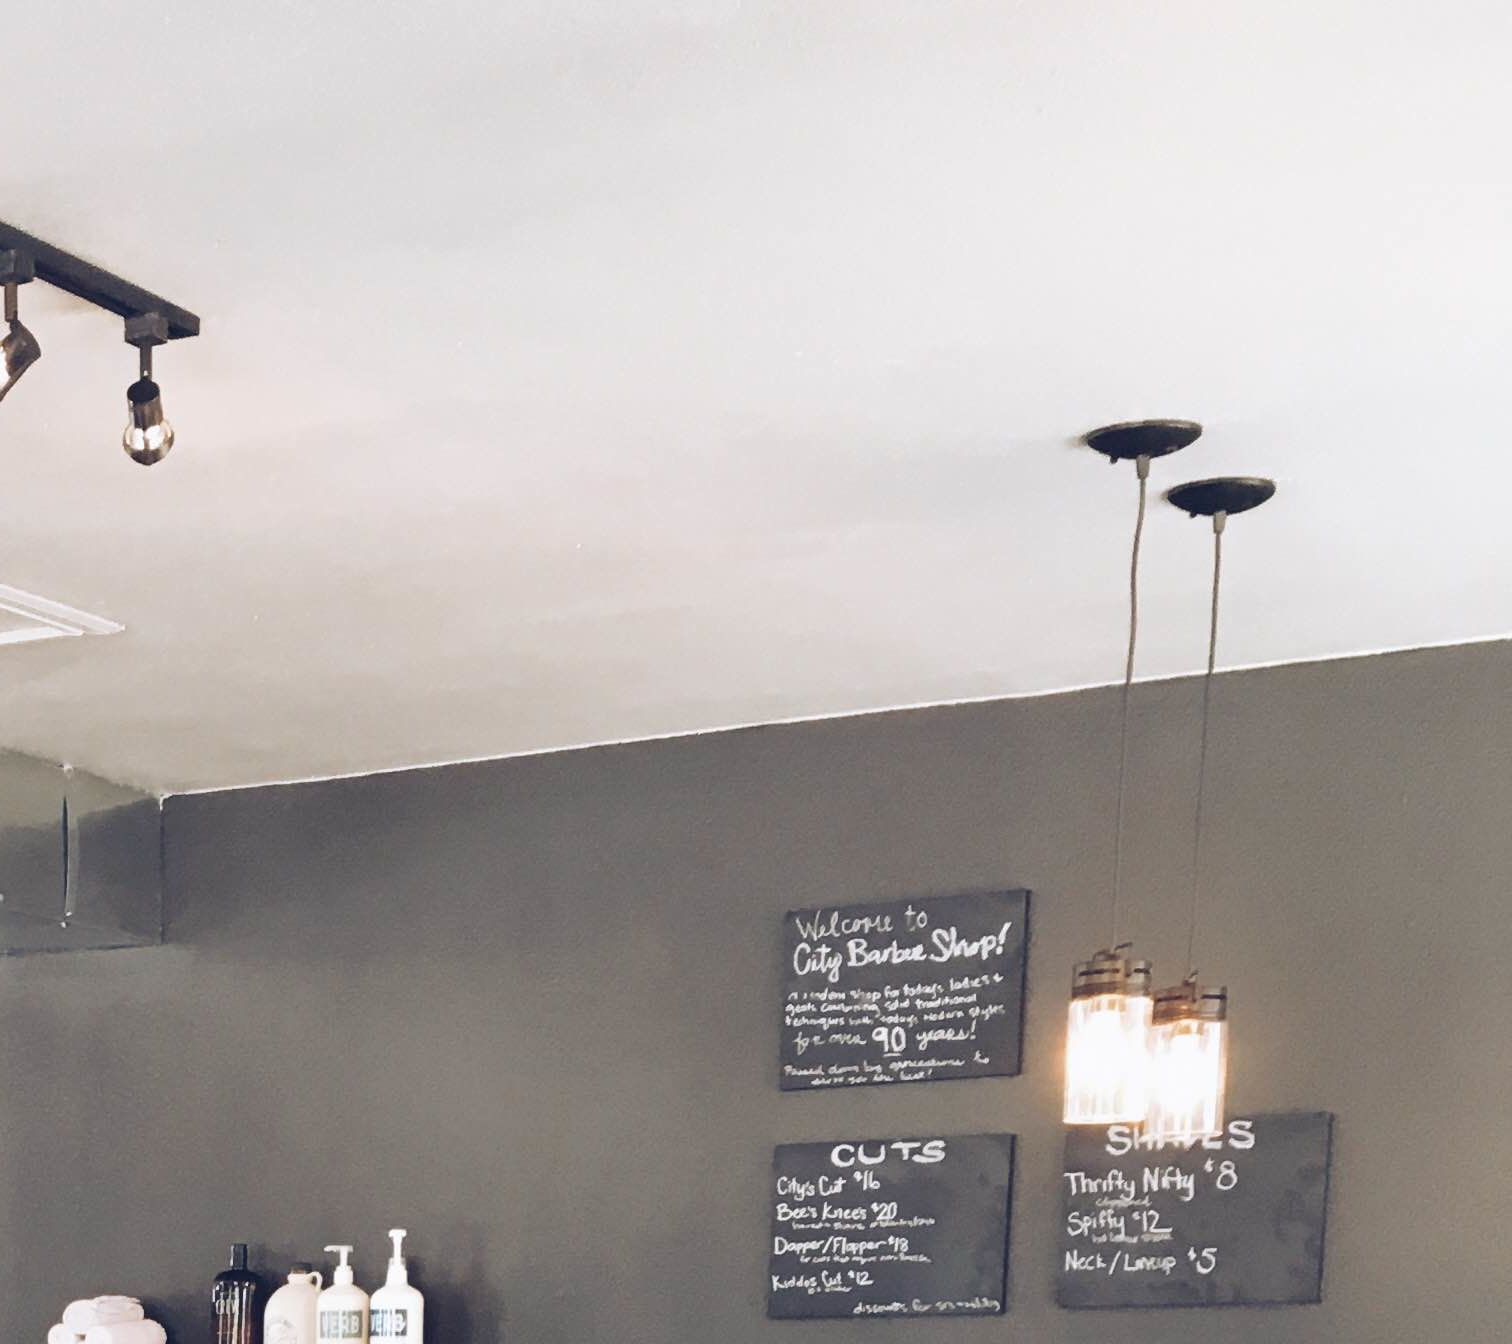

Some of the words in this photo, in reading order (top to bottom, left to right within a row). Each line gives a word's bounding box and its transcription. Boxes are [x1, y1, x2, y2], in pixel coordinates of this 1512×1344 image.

[795, 910, 893, 941] Welcome
[905, 905, 928, 931] to
[793, 942, 842, 982] City
[928, 921, 1012, 962] Shop!
[871, 1026, 906, 1052] 90
[830, 1140, 946, 1168] CUTS
[818, 1175, 847, 1197] Cut
[1064, 1169, 1136, 1201] Thrifty
[1142, 1166, 1195, 1202] Nifty
[1067, 1210, 1126, 1242] Spiffy
